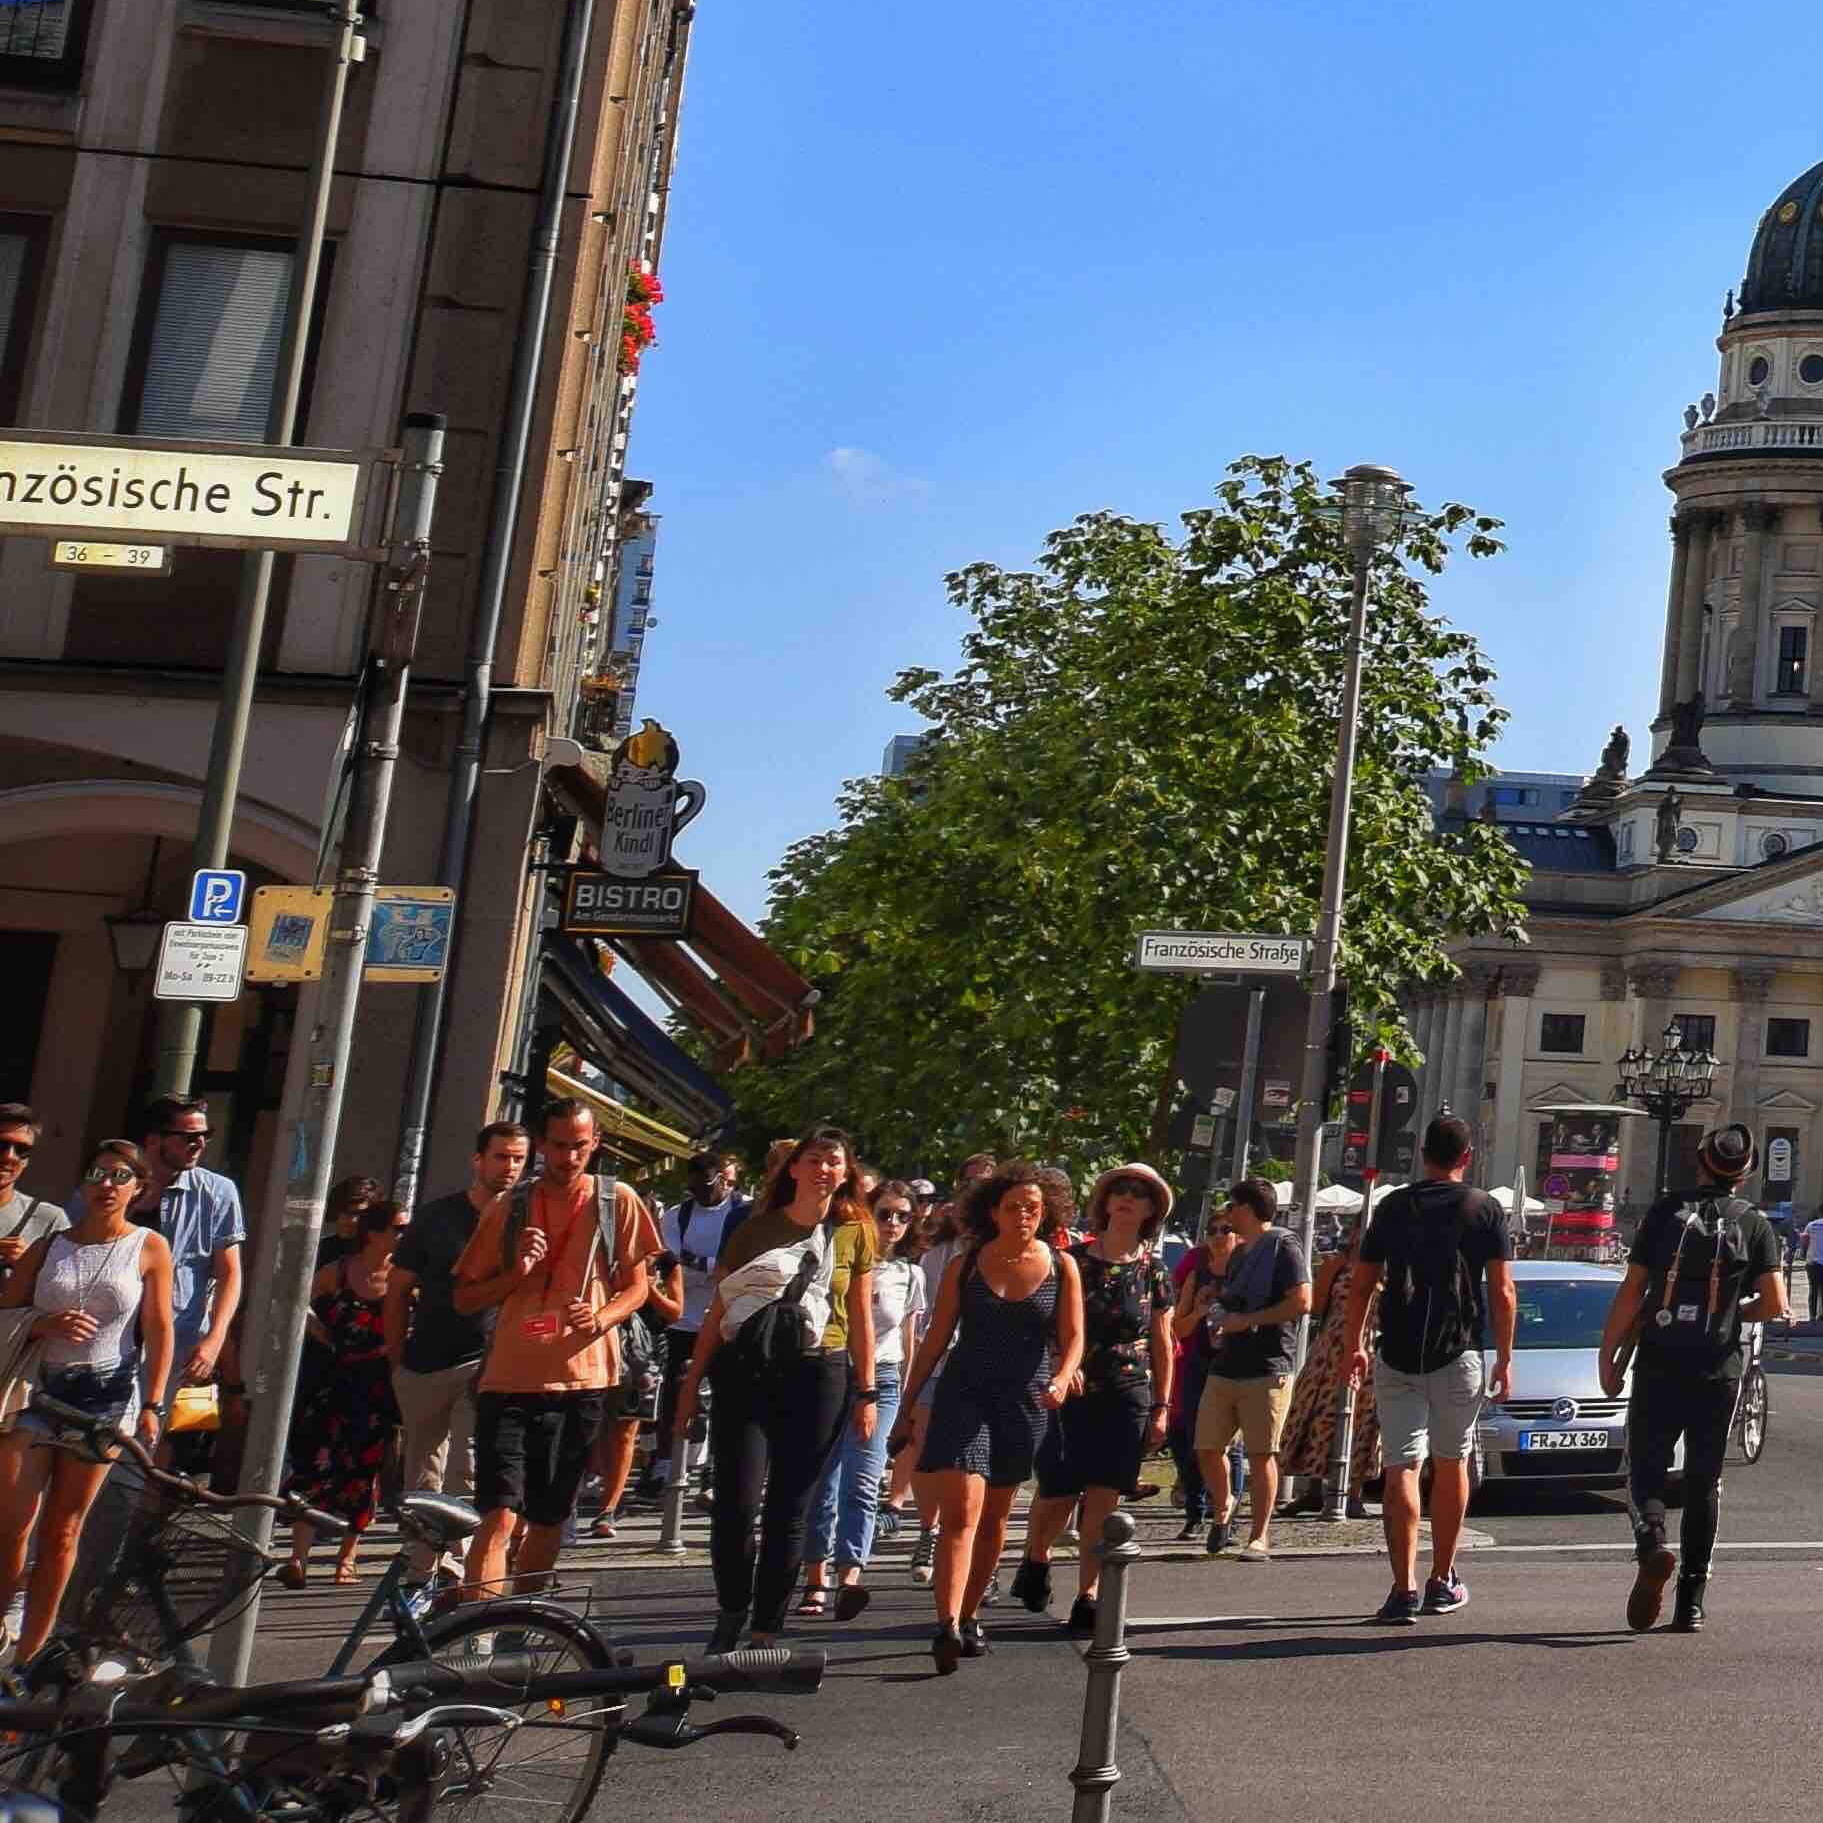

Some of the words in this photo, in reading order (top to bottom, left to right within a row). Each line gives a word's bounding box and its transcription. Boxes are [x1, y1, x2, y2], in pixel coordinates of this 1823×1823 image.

[251, 471, 331, 520] Str.
[66, 546, 87, 562] 36
[127, 550, 150, 565] 39
[607, 797, 671, 830] Berliner
[614, 832, 654, 853] Kindl
[203, 878, 233, 917] P
[576, 885, 682, 910] BISTRO
[1144, 938, 1245, 960] Französische
[1250, 941, 1299, 964] Straße
[1529, 1433, 1549, 1448] FR
[1559, 1433, 1578, 1447] ZX
[1580, 1432, 1607, 1447] 369
